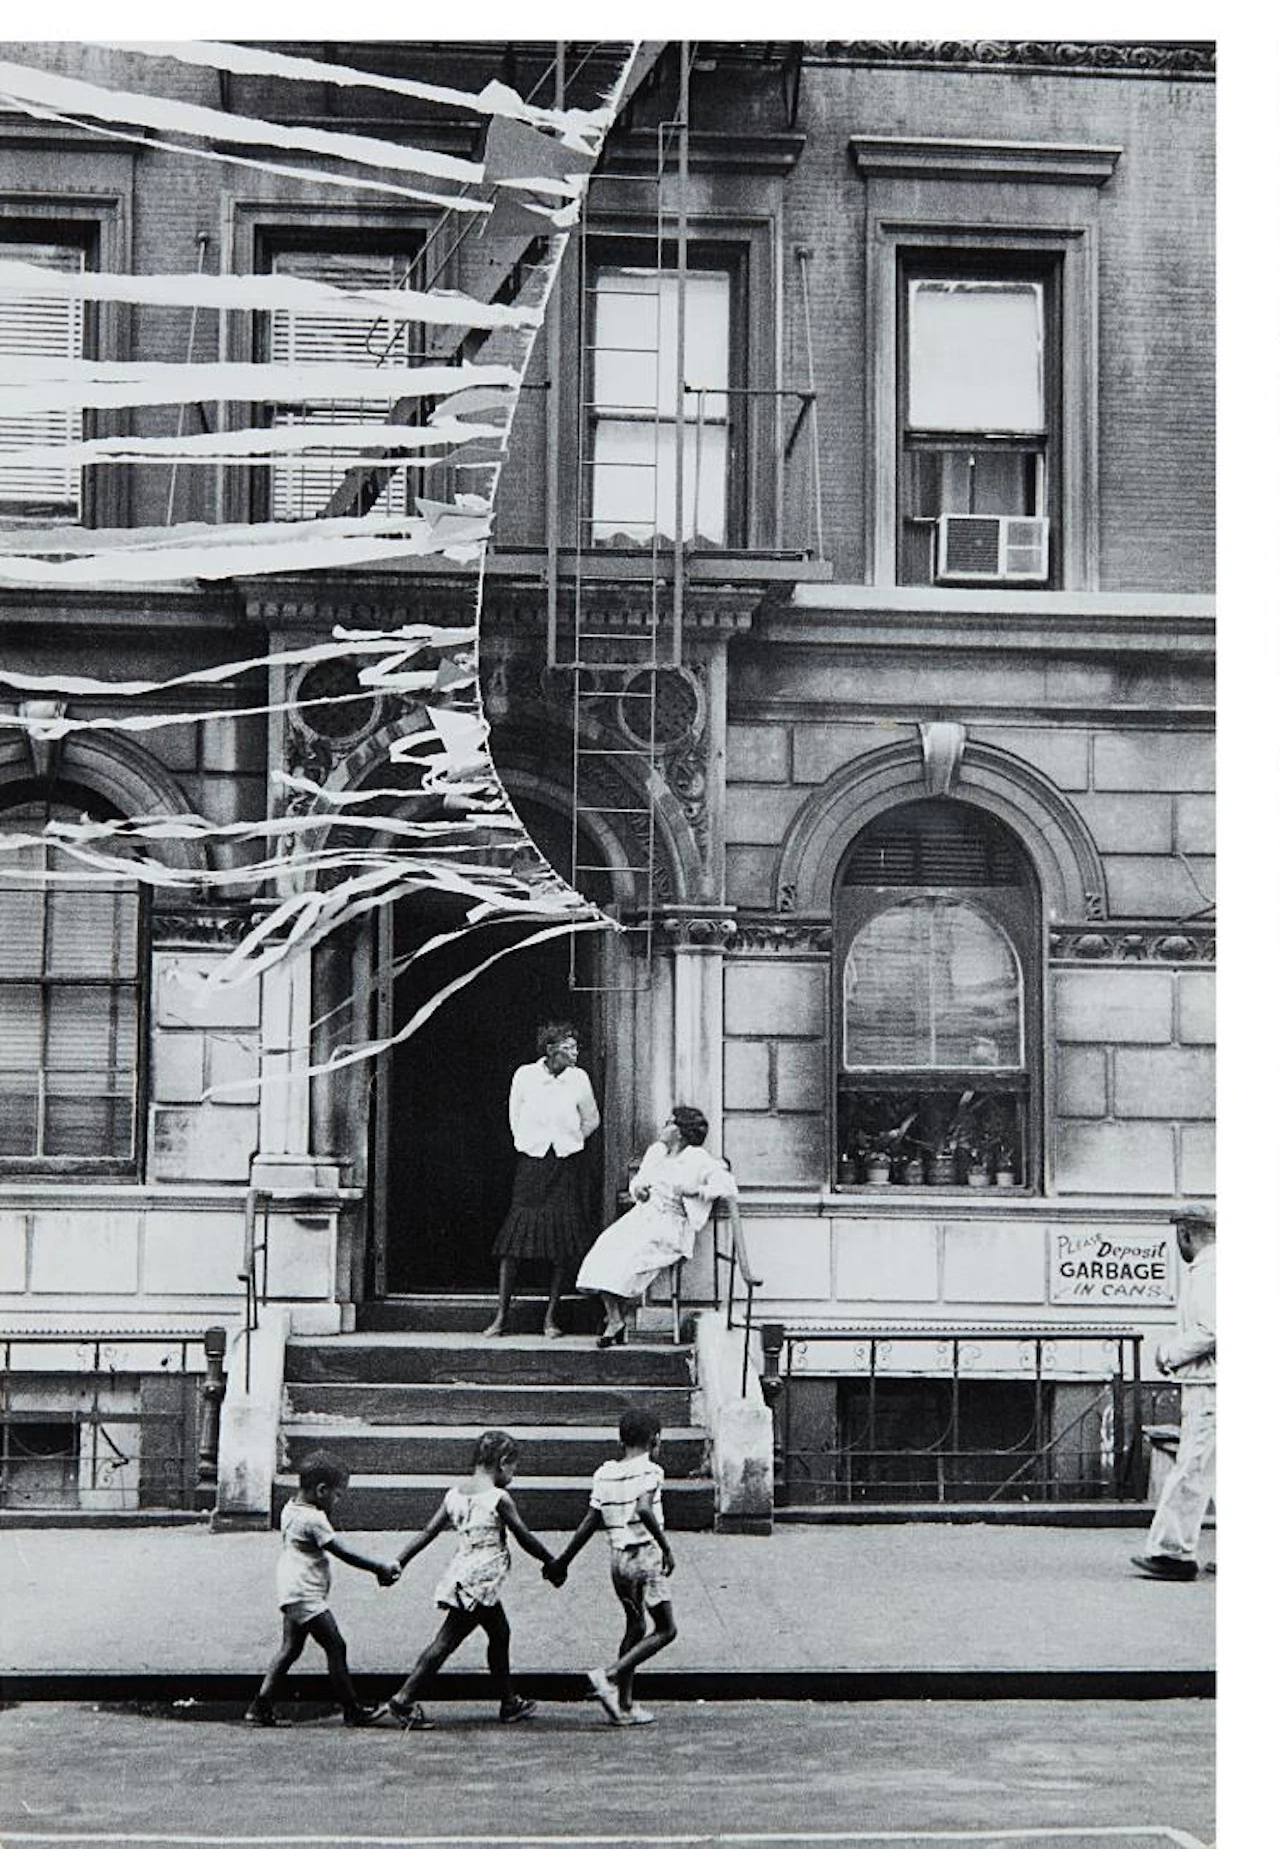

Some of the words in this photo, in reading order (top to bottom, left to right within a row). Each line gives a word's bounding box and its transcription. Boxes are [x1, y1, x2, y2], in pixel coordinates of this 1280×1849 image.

[1097, 1241, 1167, 1260] Deposit
[1060, 1262, 1166, 1280] GARBAGE
[1073, 1282, 1095, 1296] IN
[1102, 1284, 1162, 1298] CANS
